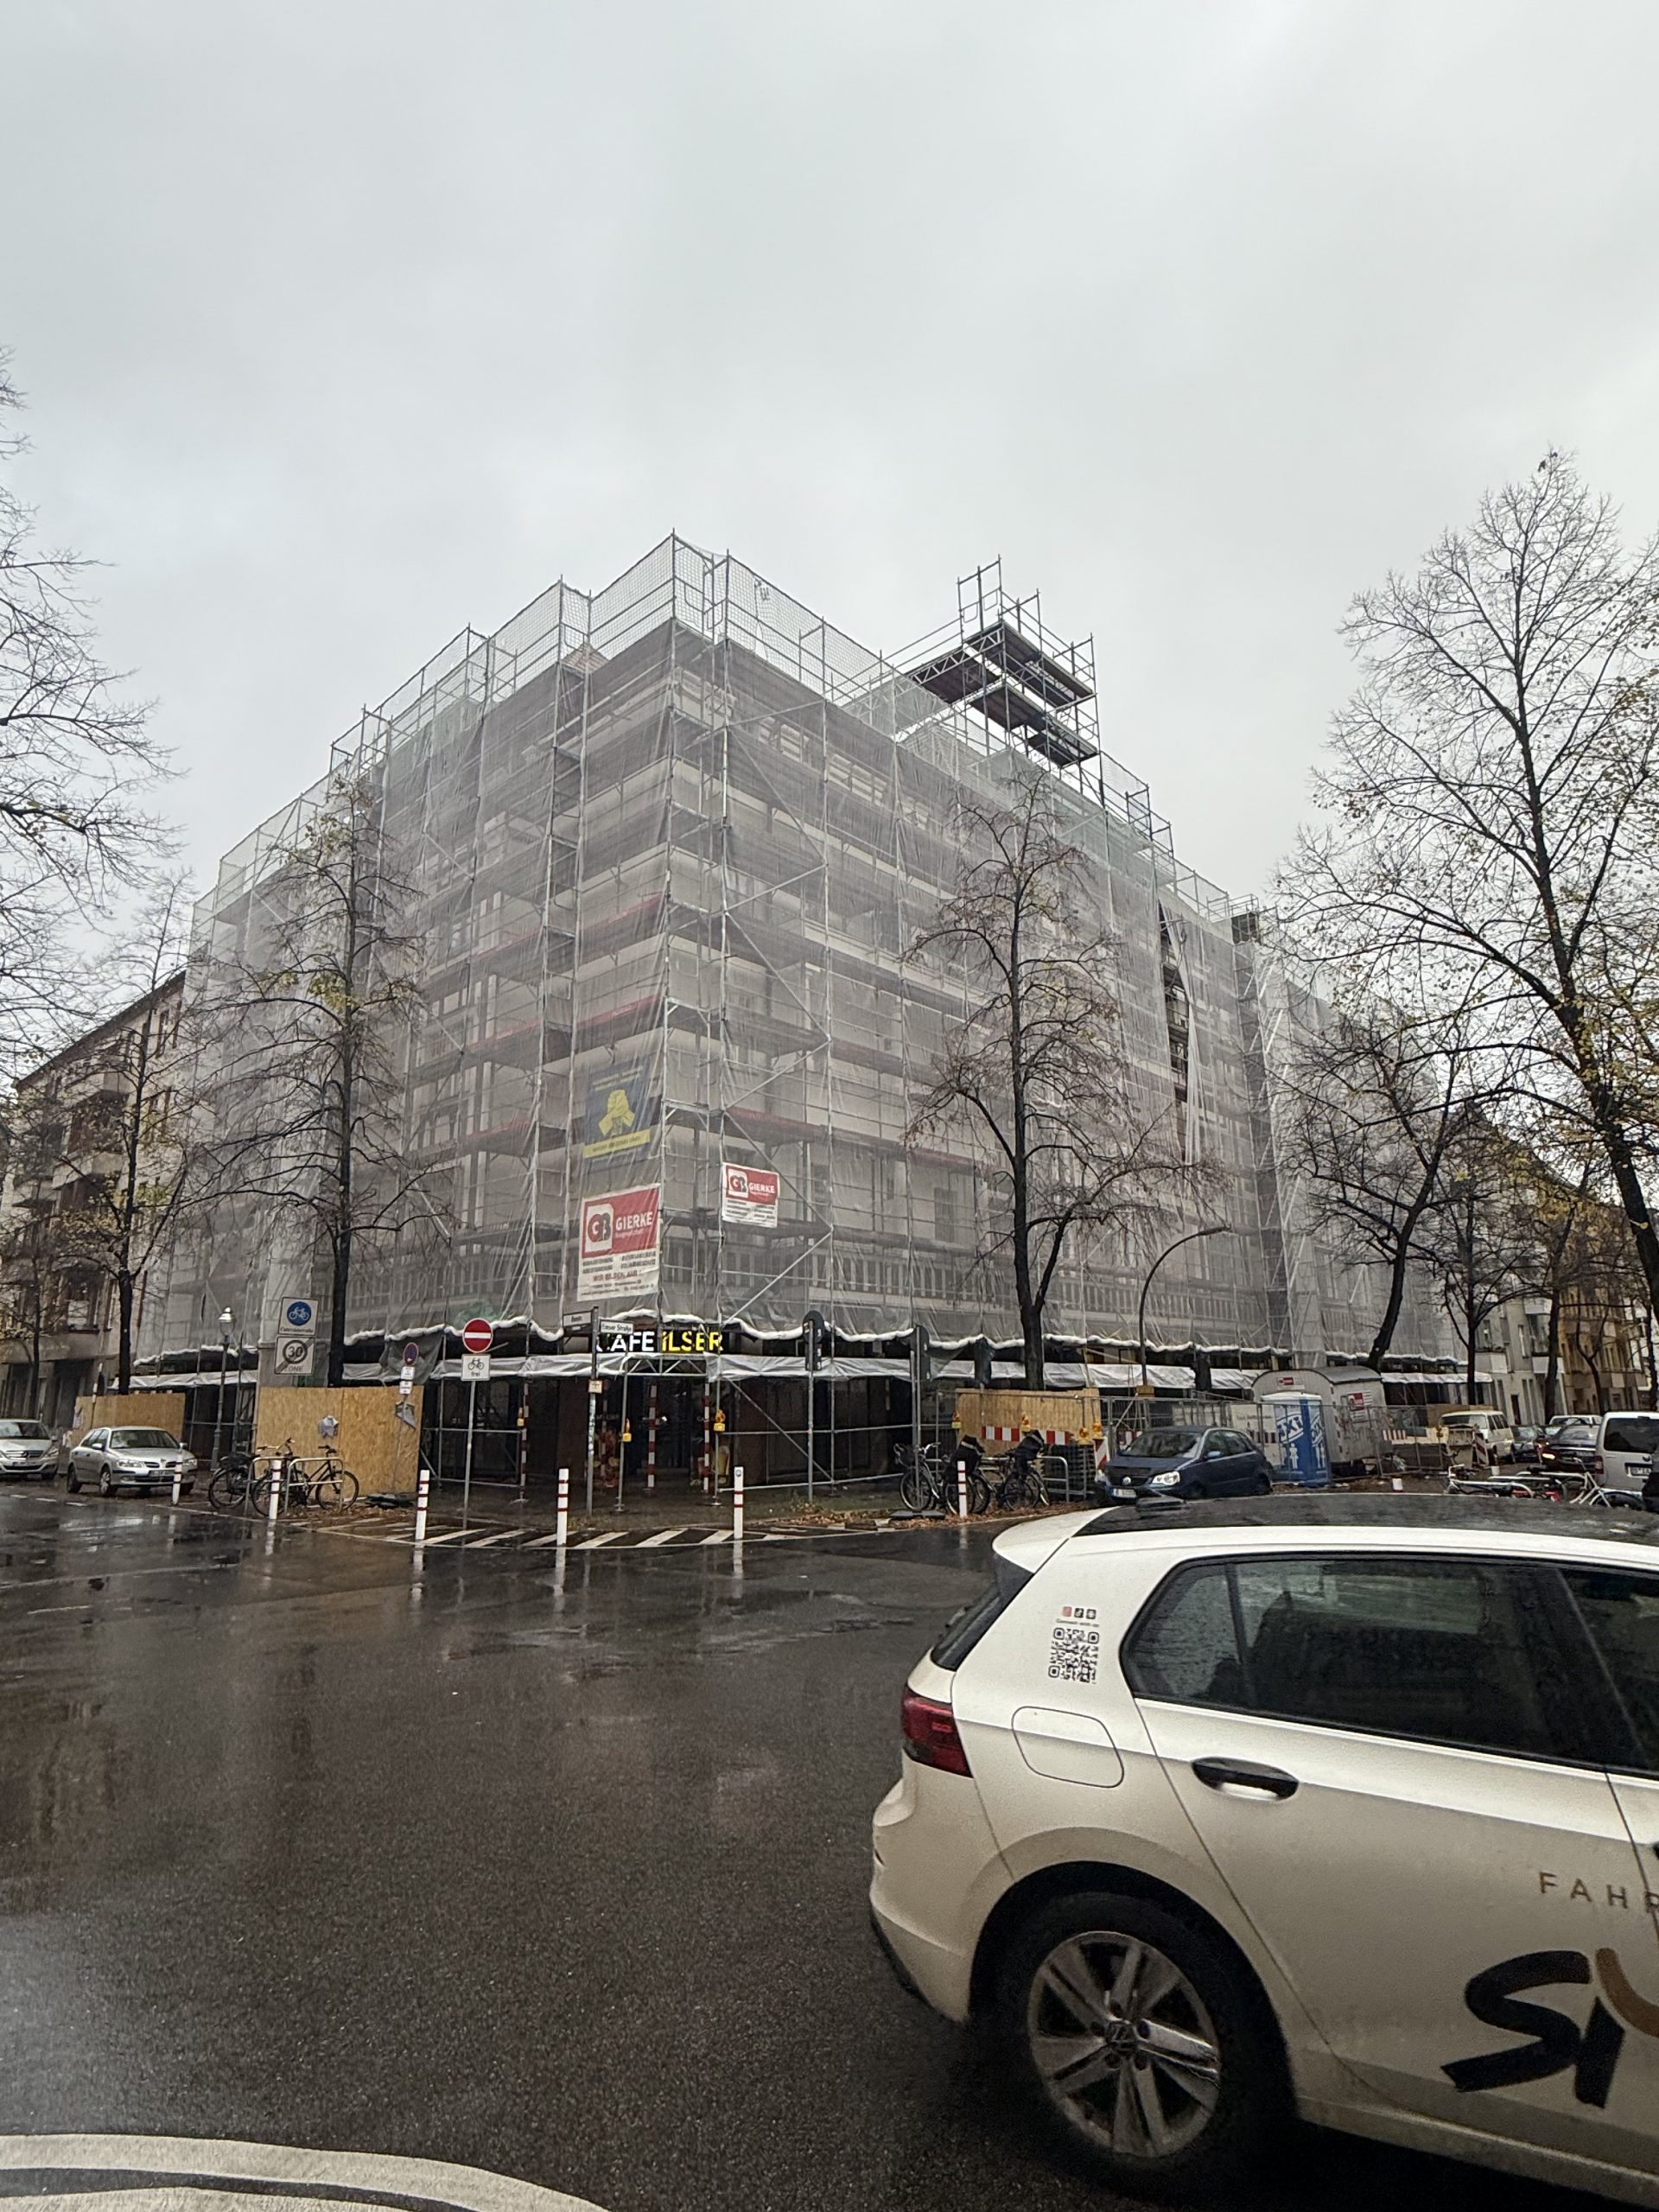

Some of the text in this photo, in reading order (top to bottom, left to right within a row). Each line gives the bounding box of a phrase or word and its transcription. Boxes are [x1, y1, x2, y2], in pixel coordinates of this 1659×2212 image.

[748, 1182, 775, 1194] GIERKE
[615, 1211, 653, 1231] GIERKE
[288, 1345, 304, 1357] 30
